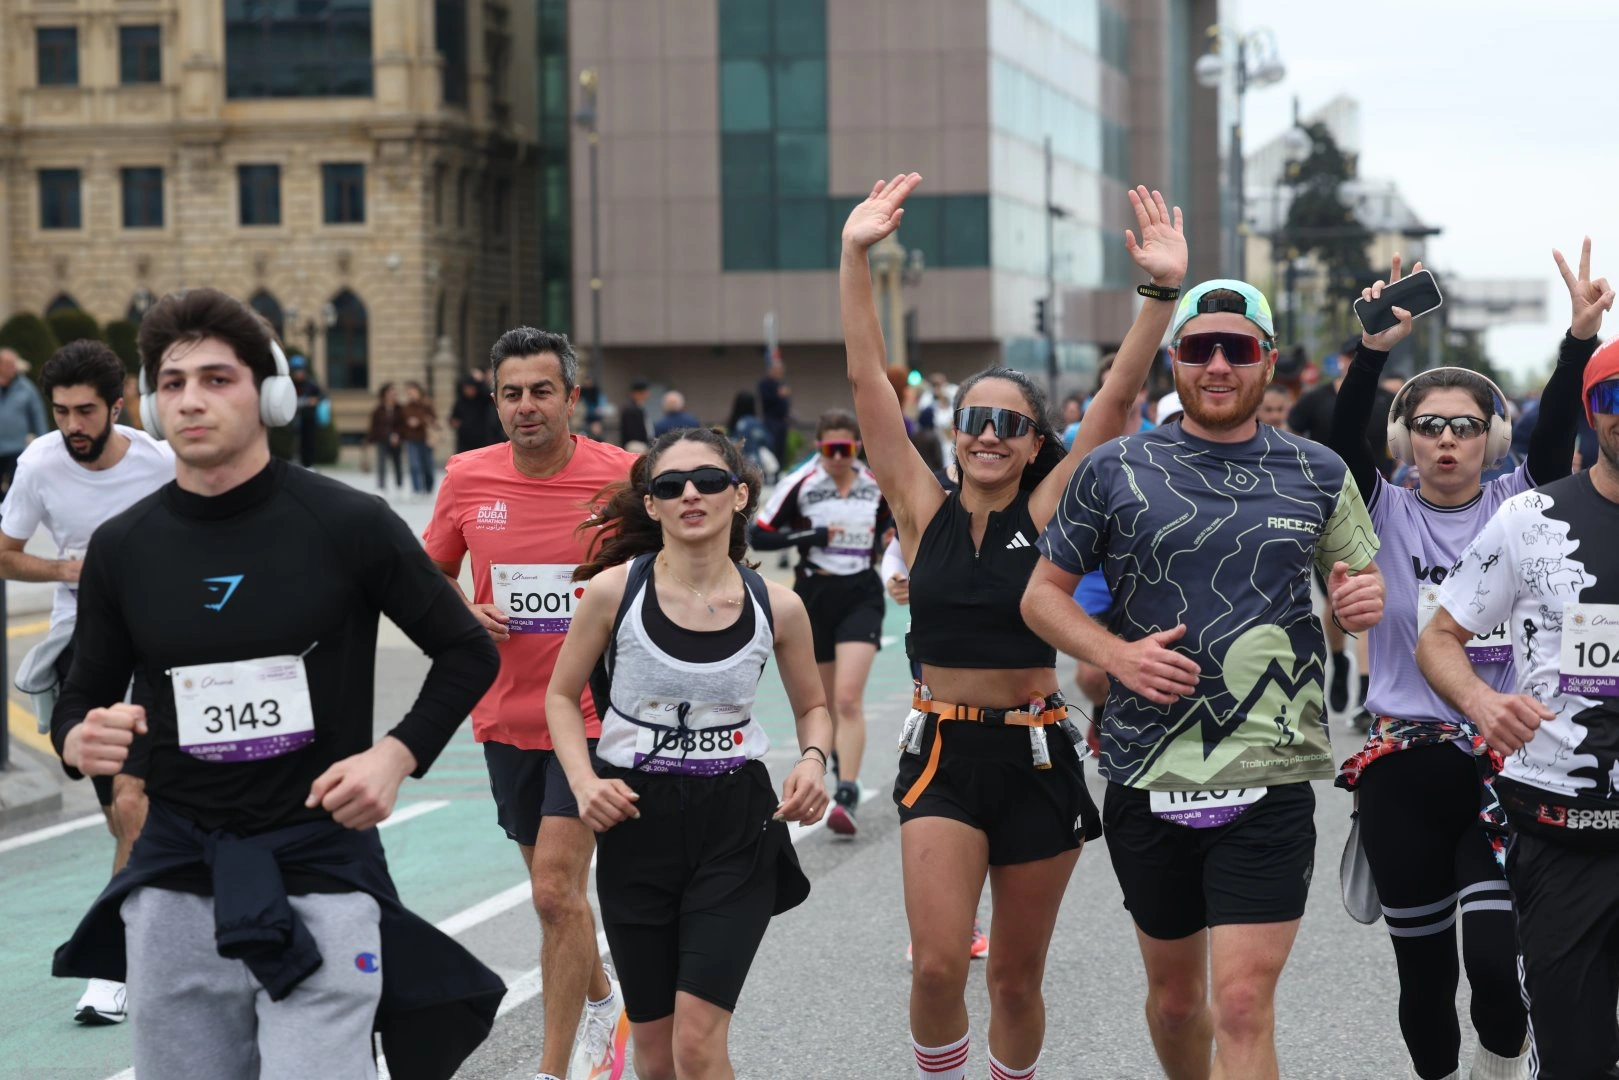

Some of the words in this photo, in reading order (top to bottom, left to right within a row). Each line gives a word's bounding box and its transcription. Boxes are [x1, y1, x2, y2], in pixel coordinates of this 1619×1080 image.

[478, 510, 507, 519] DUBAI
[510, 592, 570, 613] 5001
[1596, 676, 1616, 686] QALİB
[204, 699, 281, 734] 3143
